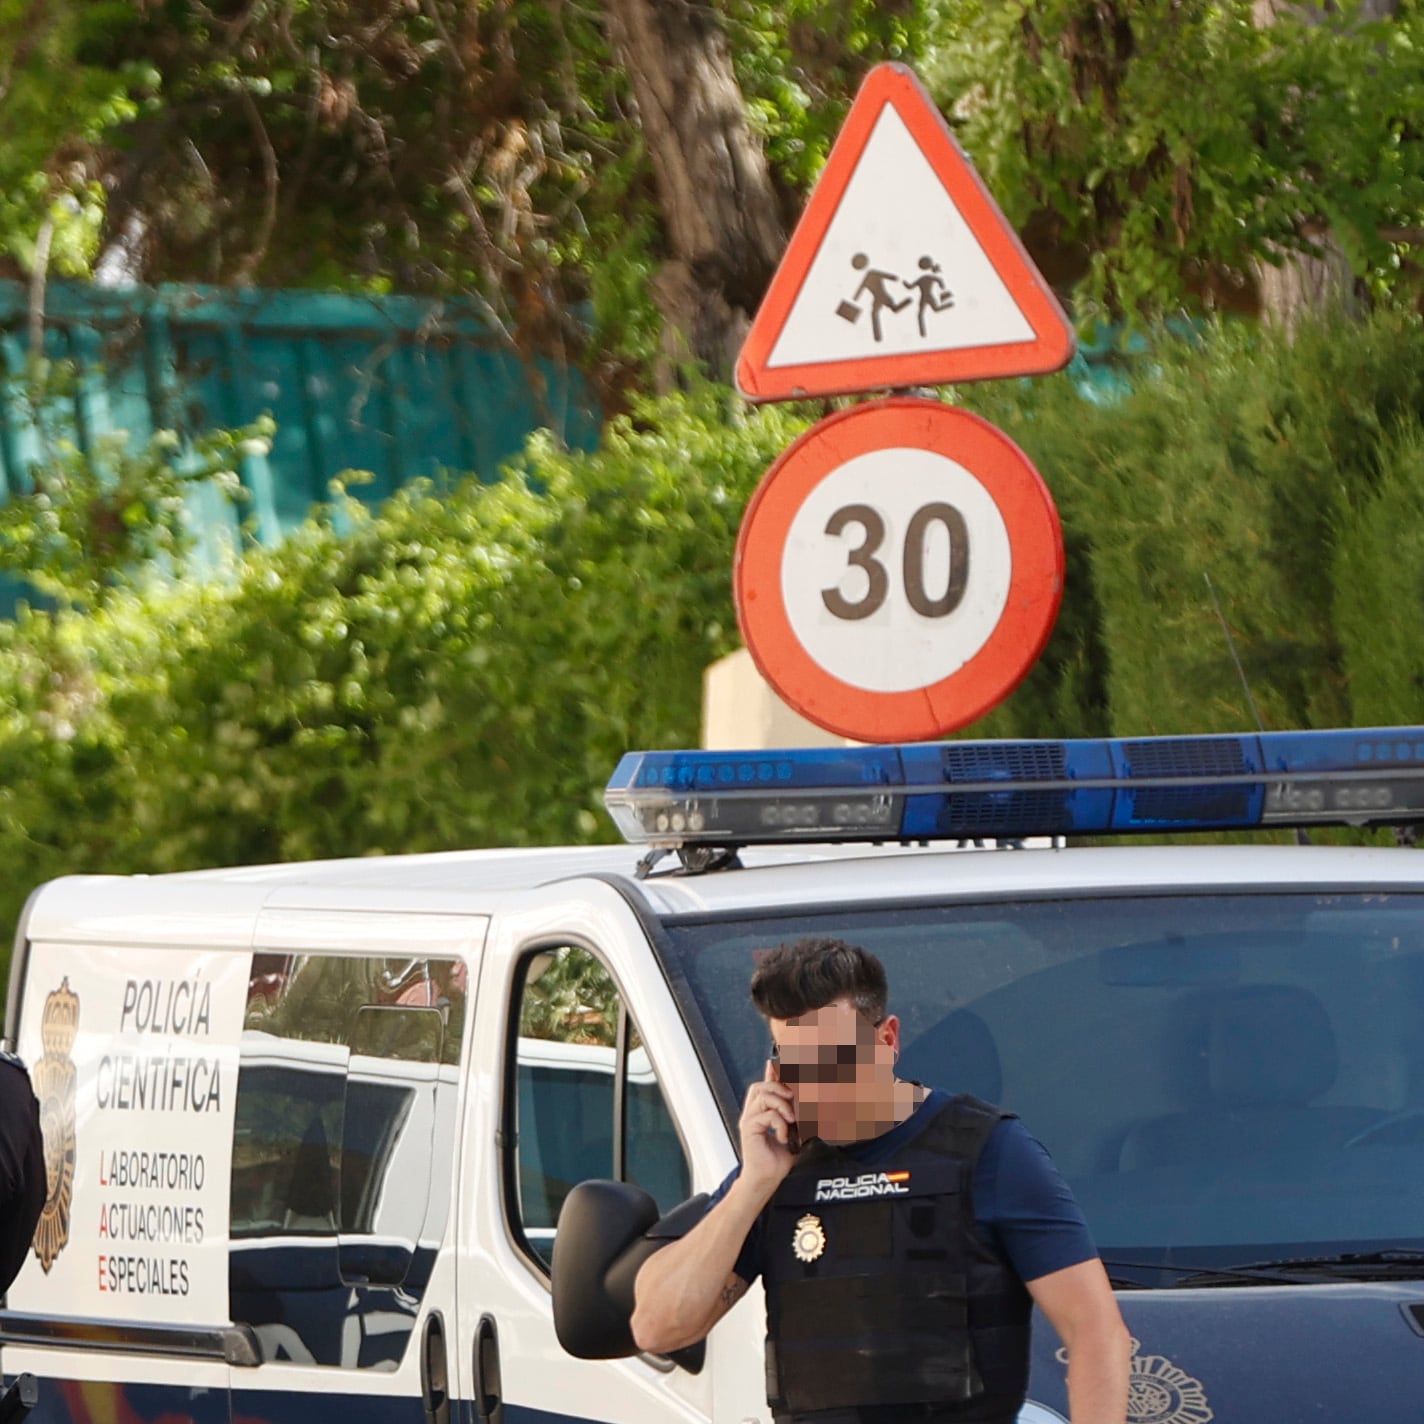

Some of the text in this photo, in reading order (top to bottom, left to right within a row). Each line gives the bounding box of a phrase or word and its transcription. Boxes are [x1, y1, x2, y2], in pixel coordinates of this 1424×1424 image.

[821, 501, 970, 621] 30
[120, 968, 210, 1035] POLICÍA
[96, 1043, 220, 1113] CIENTÍFICA
[100, 1150, 205, 1191] LABORATORIO
[816, 1182, 909, 1201] NACIONAL
[99, 1203, 204, 1244] ACTUACIONES
[98, 1255, 189, 1296] ESPECIALES
